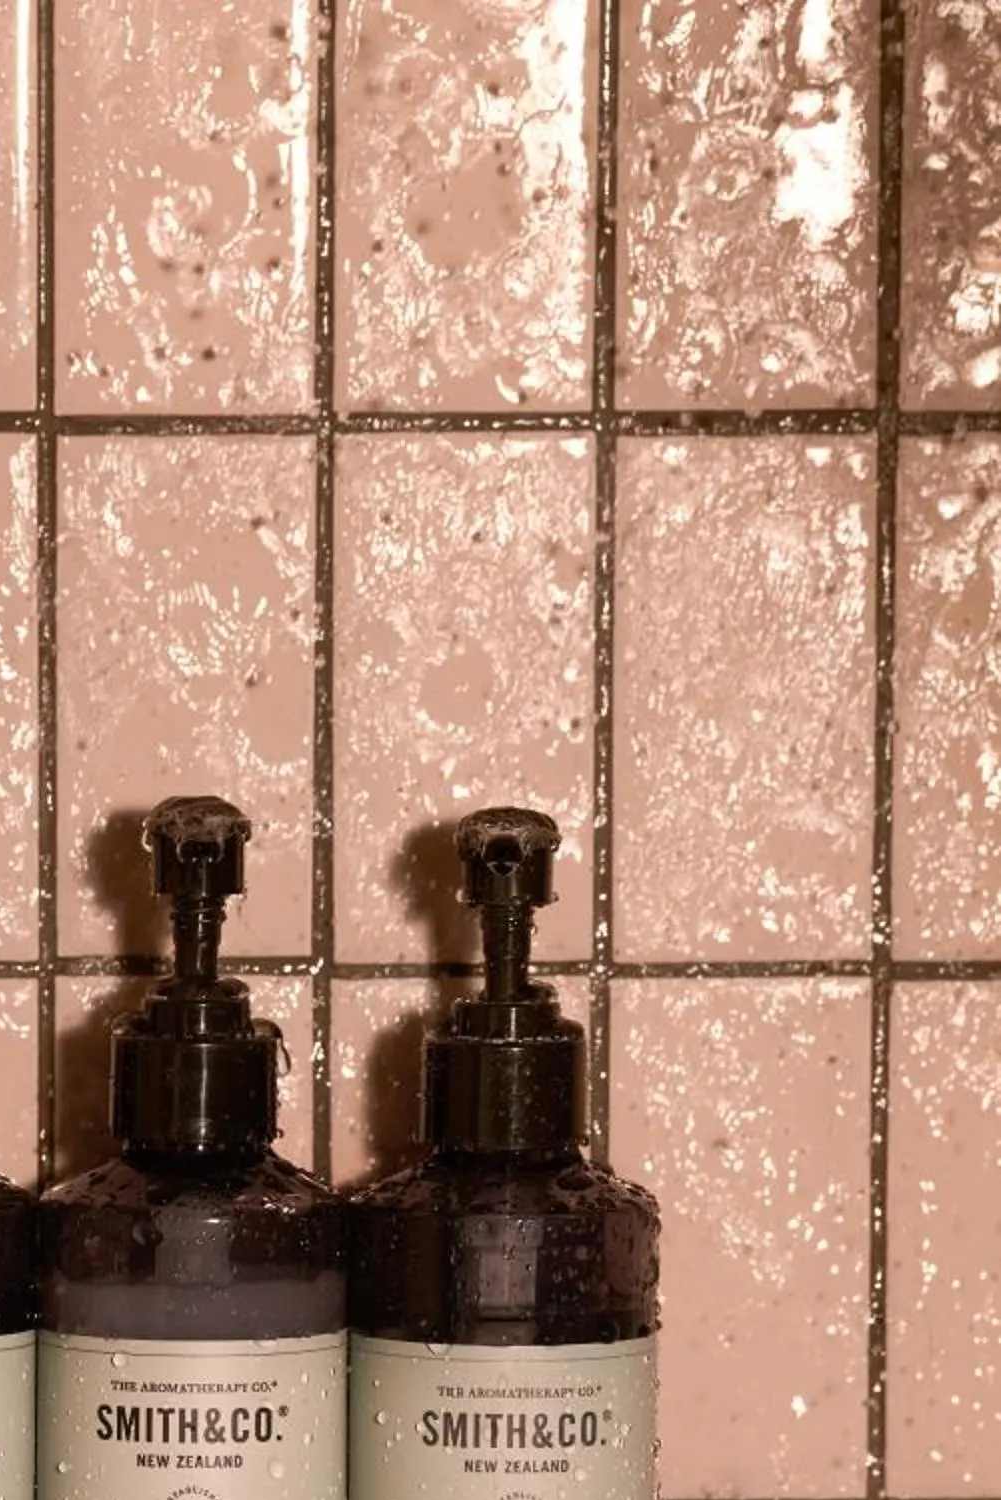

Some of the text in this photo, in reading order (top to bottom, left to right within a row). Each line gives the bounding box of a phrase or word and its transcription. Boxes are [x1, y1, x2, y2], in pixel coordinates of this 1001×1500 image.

[111, 1380, 137, 1392] THE
[141, 1381, 248, 1393] AROMATHERAPY
[436, 1386, 464, 1398] THE
[468, 1387, 575, 1399] AROMATHERAPY
[136, 1453, 243, 1468] NEW ZEALAND
[464, 1459, 570, 1473] NEW ZEALAND
